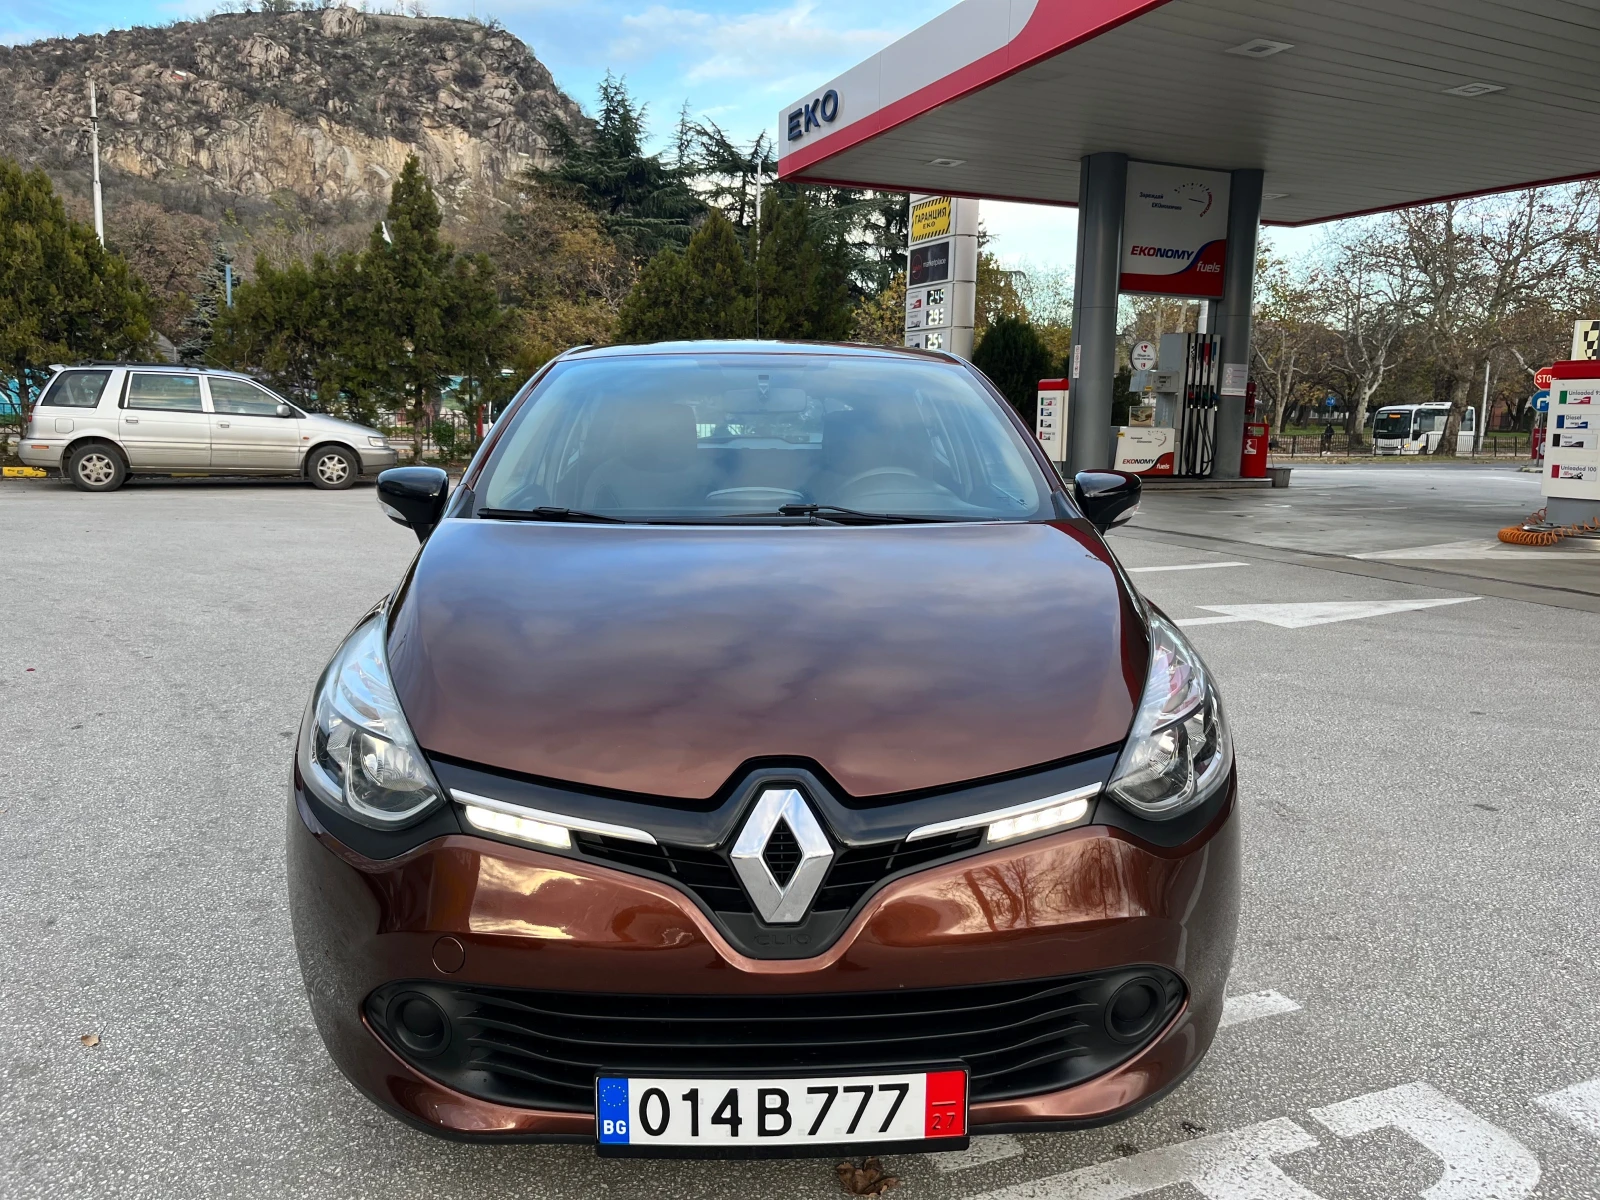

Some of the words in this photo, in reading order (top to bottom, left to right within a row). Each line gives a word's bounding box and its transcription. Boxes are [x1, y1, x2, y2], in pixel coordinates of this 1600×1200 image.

[788, 89, 838, 142] EKO
[914, 207, 947, 225] ГАРАНЦИЯ
[922, 220, 936, 230] EKO
[1130, 245, 1194, 260] EKONOMY
[1196, 261, 1221, 273] fuels
[1536, 374, 1552, 384] STO
[754, 933, 813, 946] CLIO
[603, 1119, 627, 1135] BG
[932, 1112, 956, 1129] 27
